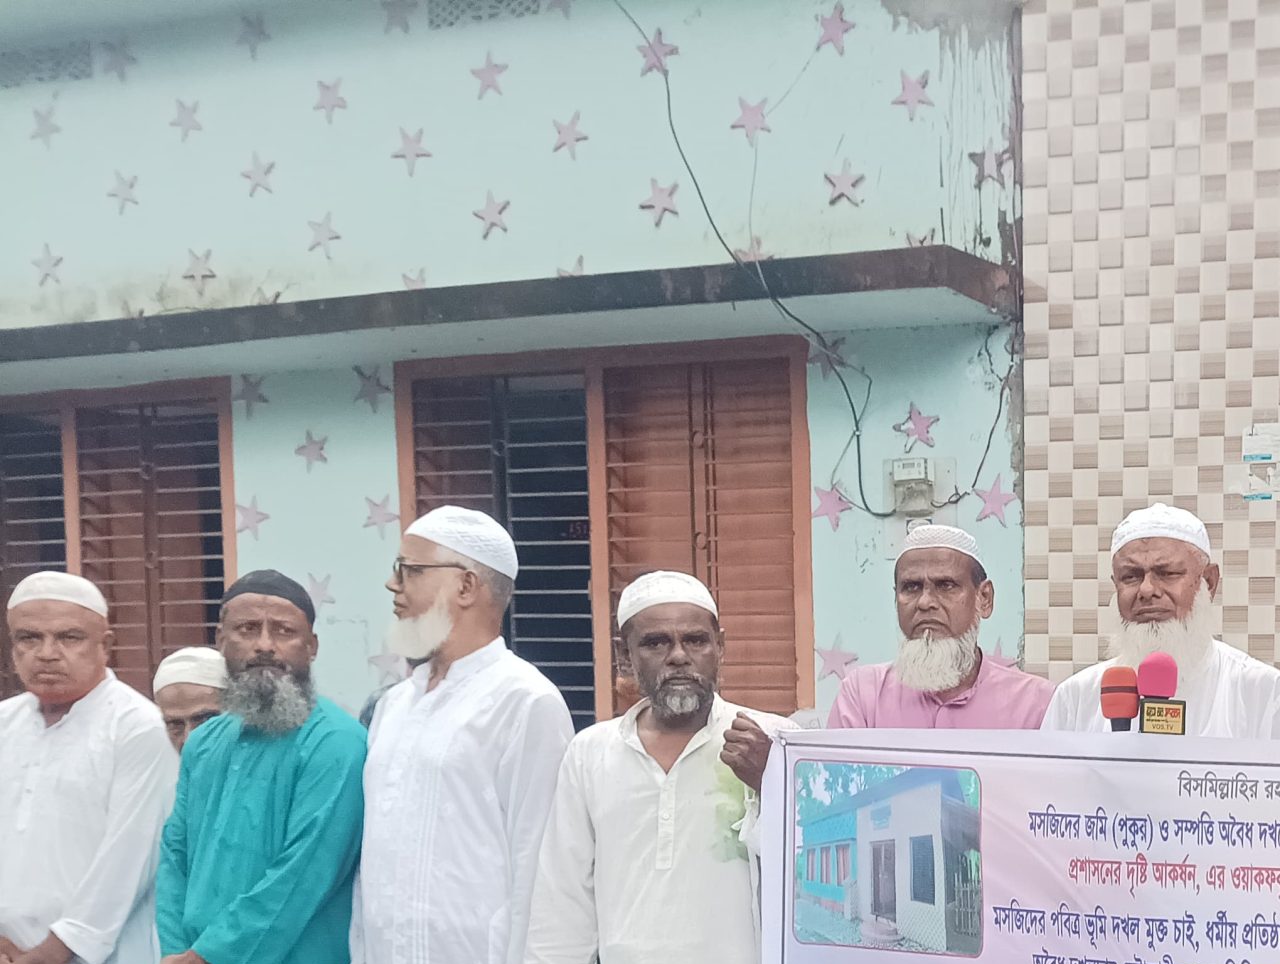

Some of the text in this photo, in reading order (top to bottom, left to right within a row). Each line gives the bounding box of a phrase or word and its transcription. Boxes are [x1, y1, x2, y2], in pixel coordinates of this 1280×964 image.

[1178, 771, 1258, 801] বিসমিল্লাহির
[1028, 804, 1080, 839] মসজিদের
[1085, 807, 1107, 841] জমি
[1113, 813, 1153, 850] (পুকুর)
[1160, 822, 1169, 841] ও
[1174, 812, 1214, 845] সম্পত্তি
[1218, 813, 1253, 847] অবৈধ
[1069, 855, 1121, 885] প্রশাসনের
[1126, 853, 1147, 897] দৃষ্টি
[1152, 855, 1200, 894] আকর্ষন,
[1205, 864, 1225, 890] এর
[992, 898, 1045, 935] মসজিদের
[1051, 903, 1080, 938] পবিত্র
[1085, 905, 1107, 949] ভূমি
[1112, 914, 1140, 944] দখল
[1145, 917, 1168, 949] মুক্ত
[1173, 910, 1200, 952] চাই,
[1205, 910, 1237, 949] ধর্মীয়
